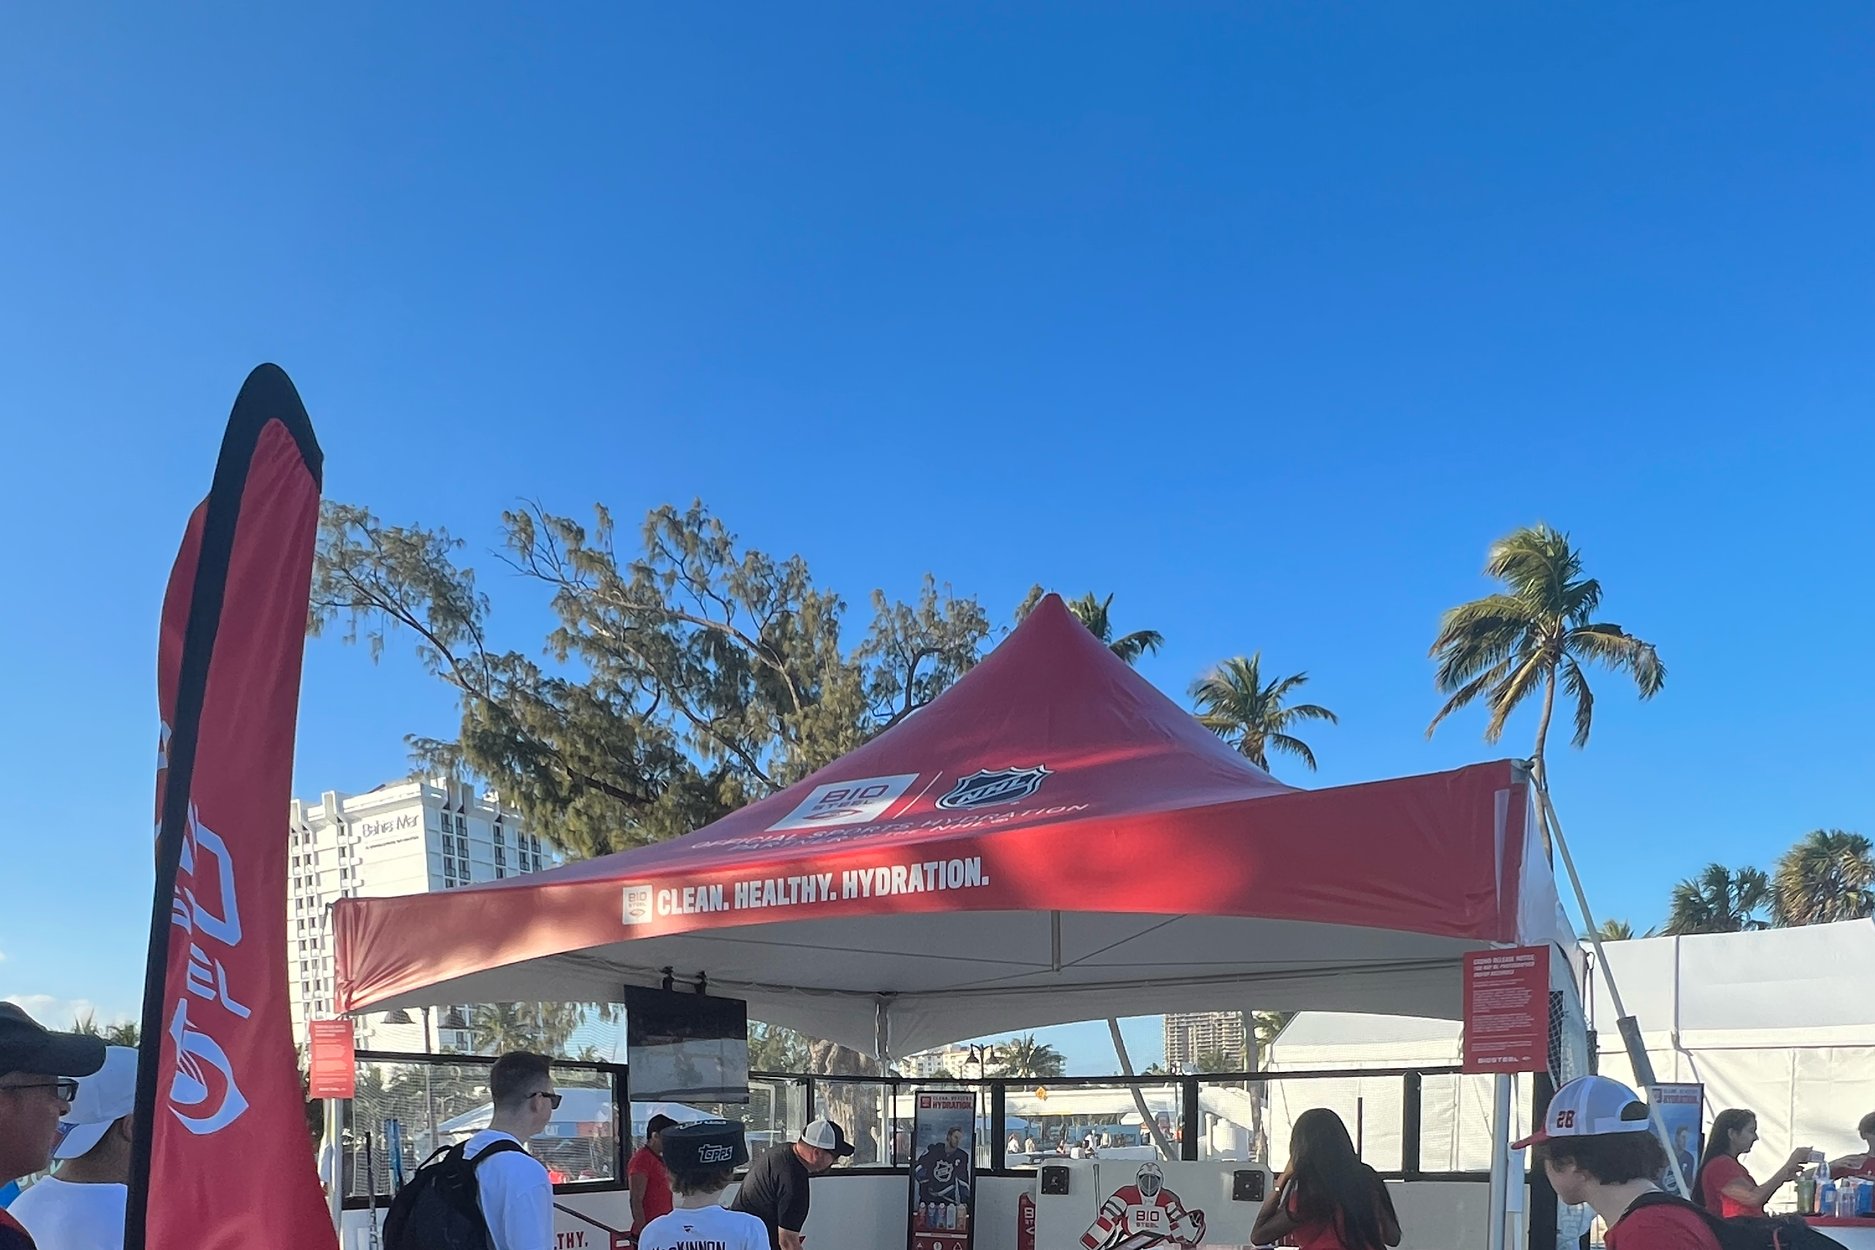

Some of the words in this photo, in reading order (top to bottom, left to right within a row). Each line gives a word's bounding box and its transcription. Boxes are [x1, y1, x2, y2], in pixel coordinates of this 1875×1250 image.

[819, 785, 890, 803] BIO
[955, 777, 1027, 805] NHL
[811, 800, 874, 811] STEEL
[396, 814, 419, 830] Mar
[920, 804, 1089, 829] HYDRATION
[658, 884, 729, 916] CLEAN.
[735, 873, 837, 909] HEALTHY.
[842, 856, 990, 900] HYDRATION.
[628, 891, 647, 902] BIO
[1556, 1110, 1576, 1128] 28
[1135, 1210, 1160, 1222] BIO
[554, 1231, 588, 1250] THY.
